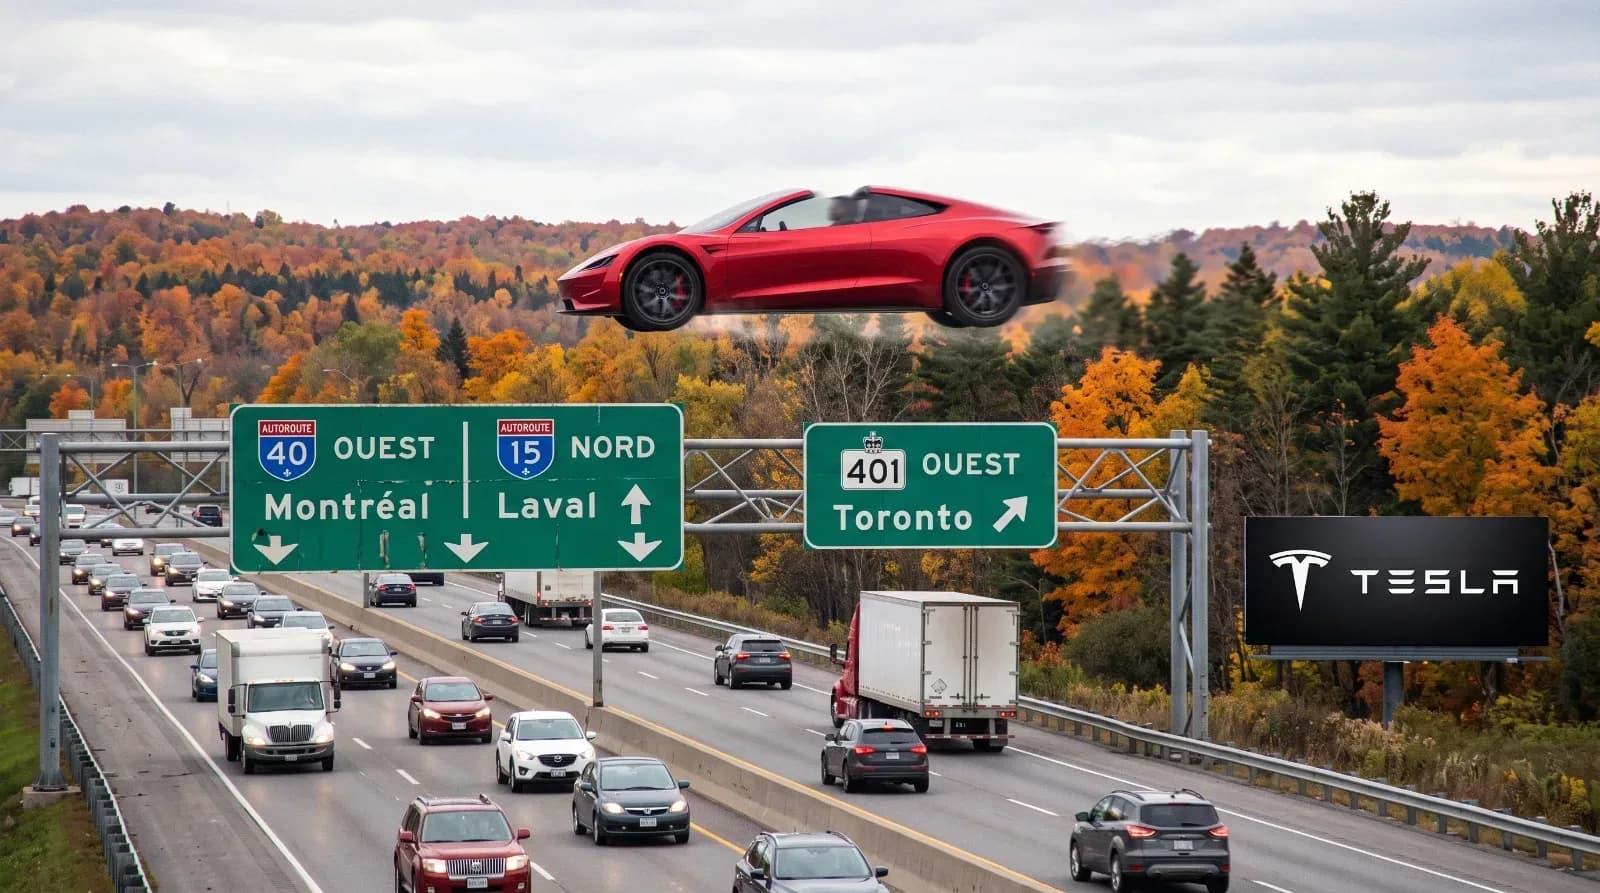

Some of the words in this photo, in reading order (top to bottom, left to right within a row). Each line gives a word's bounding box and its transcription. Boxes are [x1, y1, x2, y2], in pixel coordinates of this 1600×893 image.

[261, 423, 313, 435] AUTOROUTE
[500, 422, 551, 434] AUTOROUTE
[266, 441, 308, 466] 40
[334, 436, 435, 460] OUEST
[511, 440, 541, 465] 15
[571, 435, 655, 459] NORD
[847, 458, 899, 484] 401
[922, 452, 1021, 476] OUEST
[265, 490, 429, 521] Montréal
[498, 491, 596, 519] Laval
[833, 503, 973, 531] Toronto
[1350, 569, 1519, 595] TESLA
